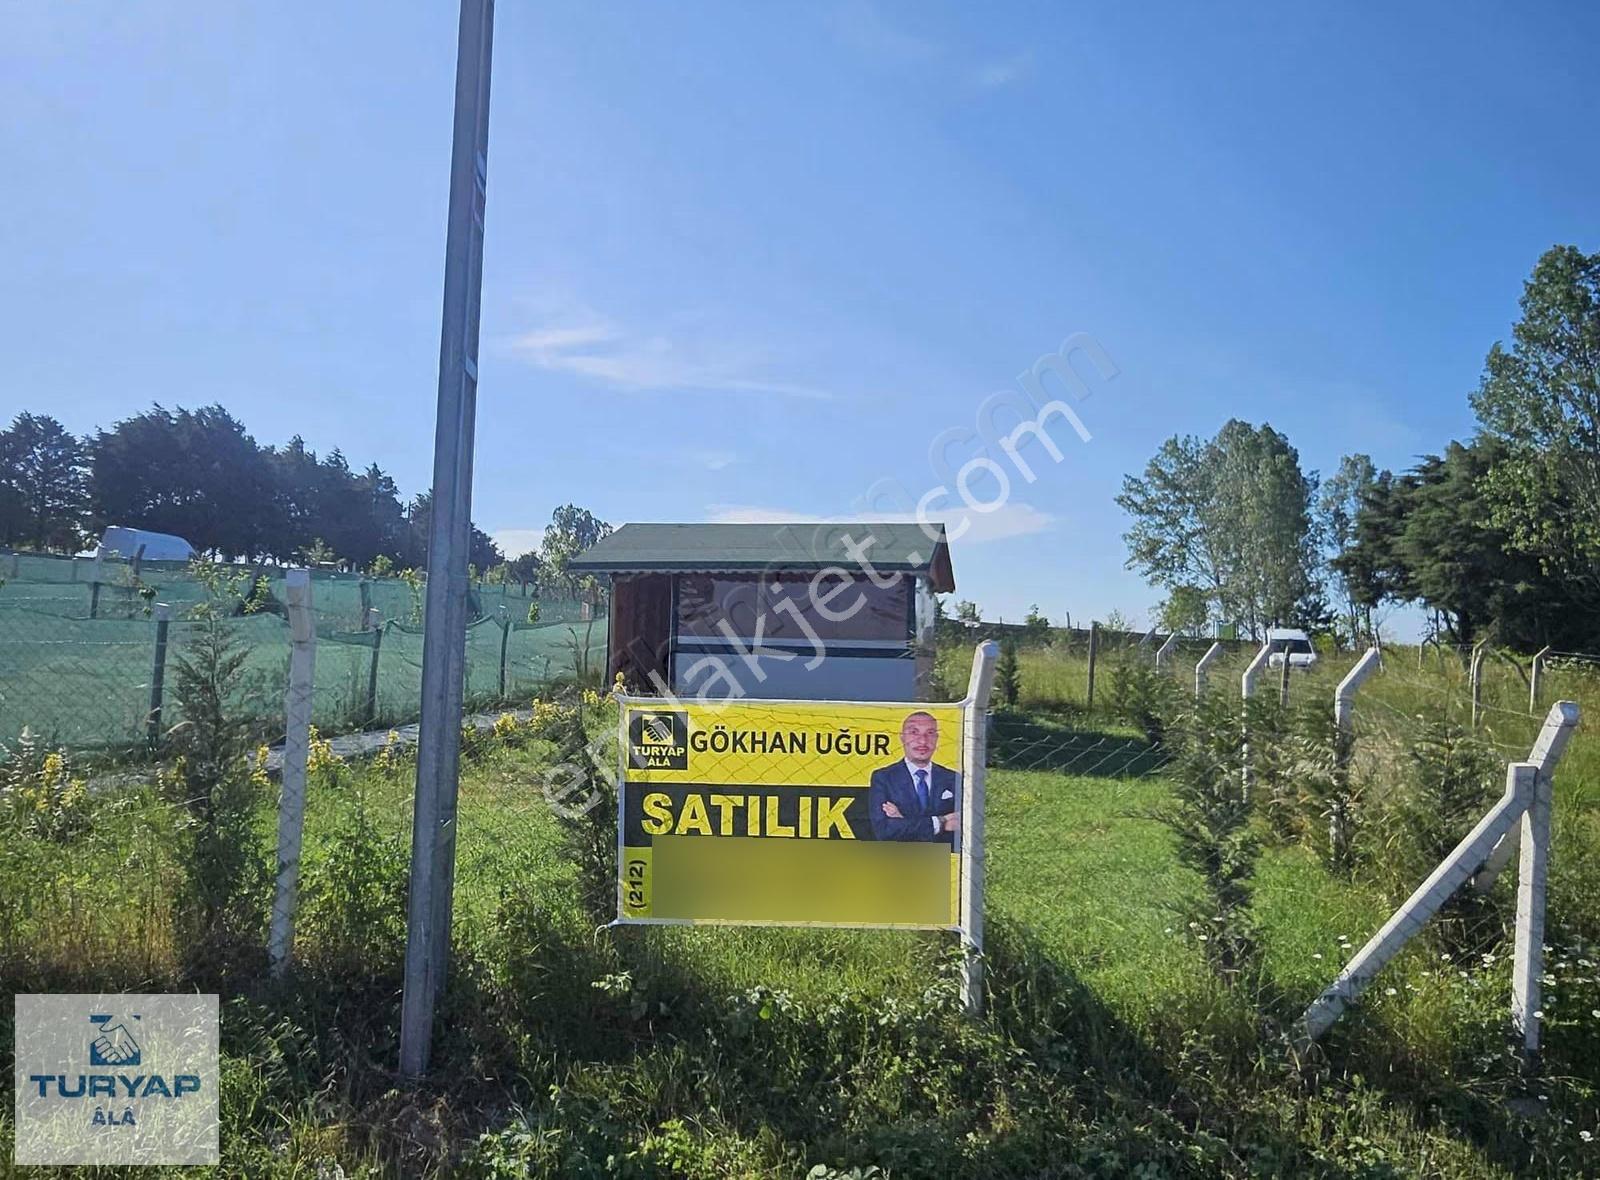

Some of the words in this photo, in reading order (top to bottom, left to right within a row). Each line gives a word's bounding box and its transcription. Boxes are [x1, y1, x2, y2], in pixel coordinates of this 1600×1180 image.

[632, 745, 685, 757] TURYAP
[690, 725, 807, 754] GÖKHAN
[815, 729, 891, 756] UĞUR
[640, 793, 856, 839] SATILIK
[628, 859, 648, 909] (212)
